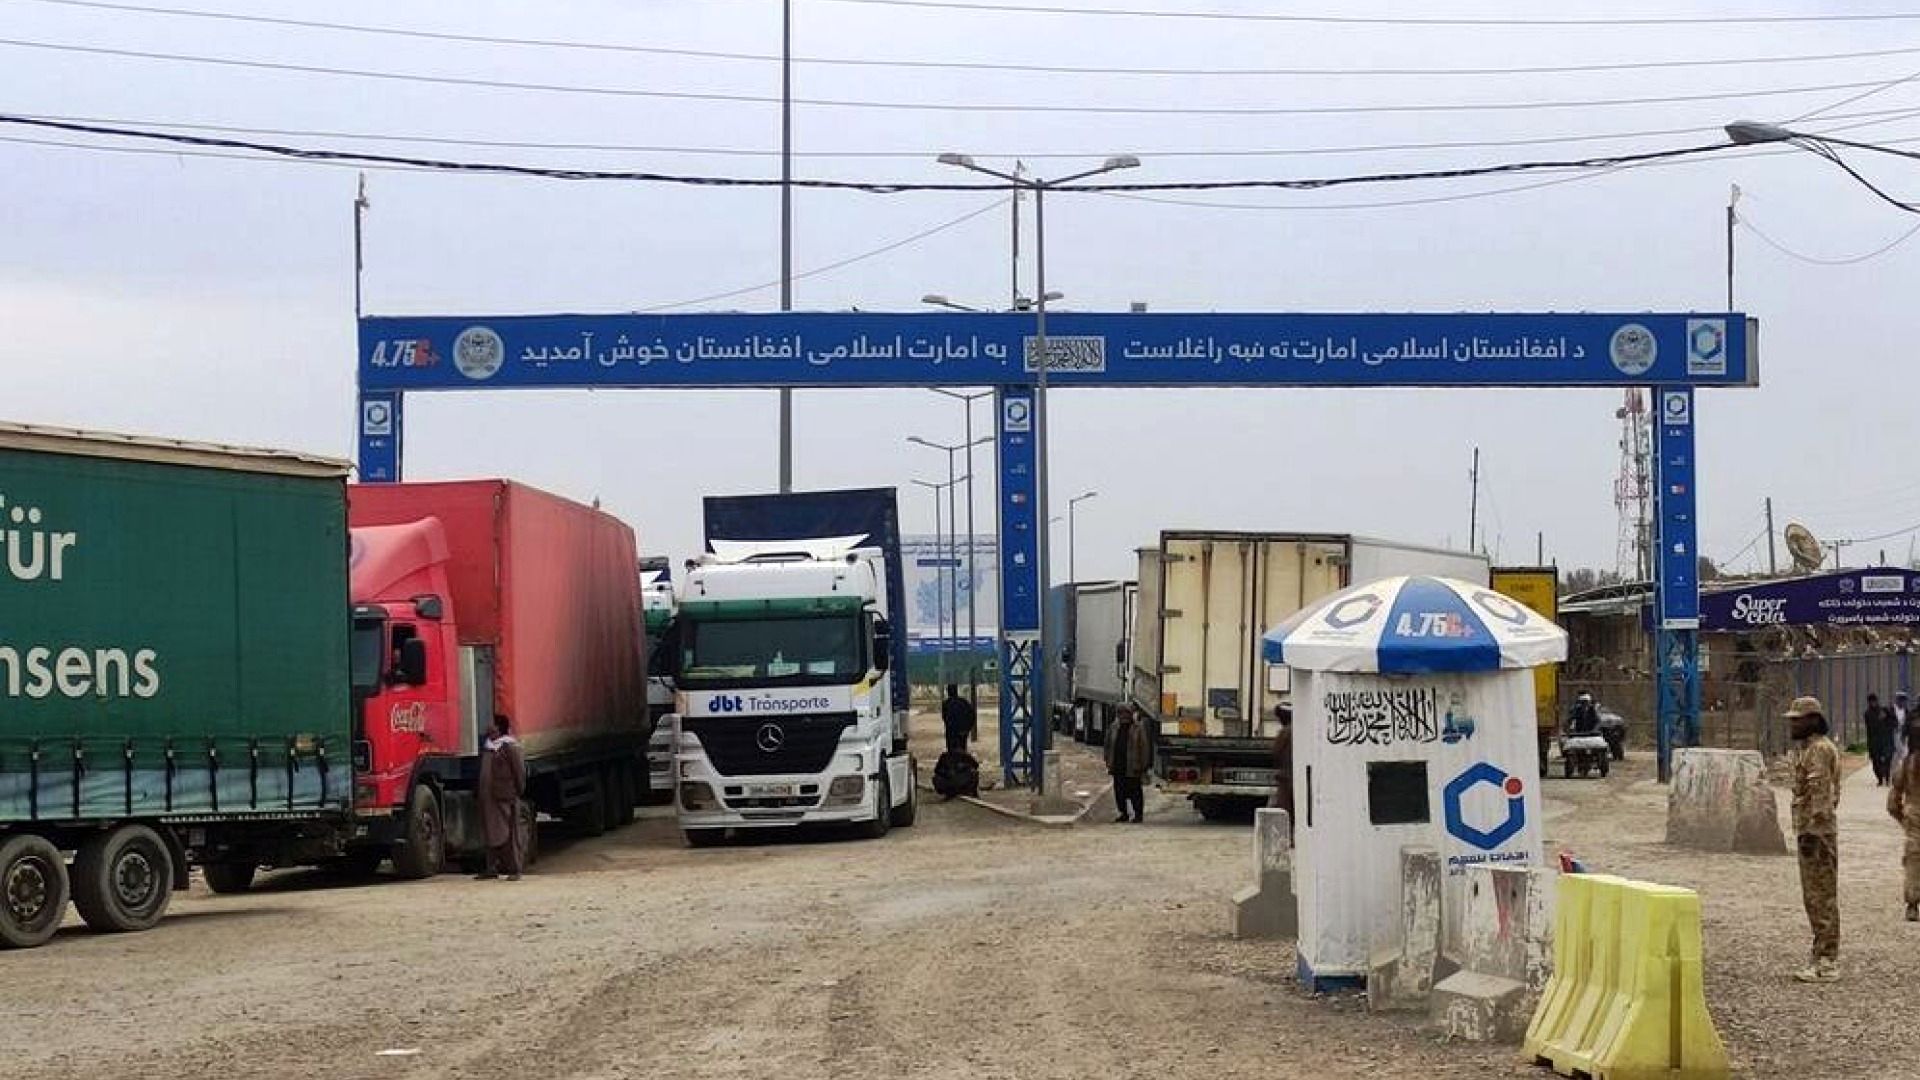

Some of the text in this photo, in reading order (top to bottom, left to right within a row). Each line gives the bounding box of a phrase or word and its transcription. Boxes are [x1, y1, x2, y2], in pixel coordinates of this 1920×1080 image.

[521, 331, 593, 368] آمدید
[599, 334, 670, 366] خوش
[675, 335, 802, 363] افغانستان
[908, 335, 978, 364] امارت
[984, 344, 1008, 365] به
[1124, 337, 1223, 364] راغلاست
[1269, 341, 1289, 359] ته
[1292, 337, 1357, 364] امارت
[1454, 336, 1566, 362] افغانستان
[1573, 345, 1586, 358] د
[0, 494, 76, 580] ür
[1732, 594, 1787, 619] Super
[709, 695, 743, 712] dbt
